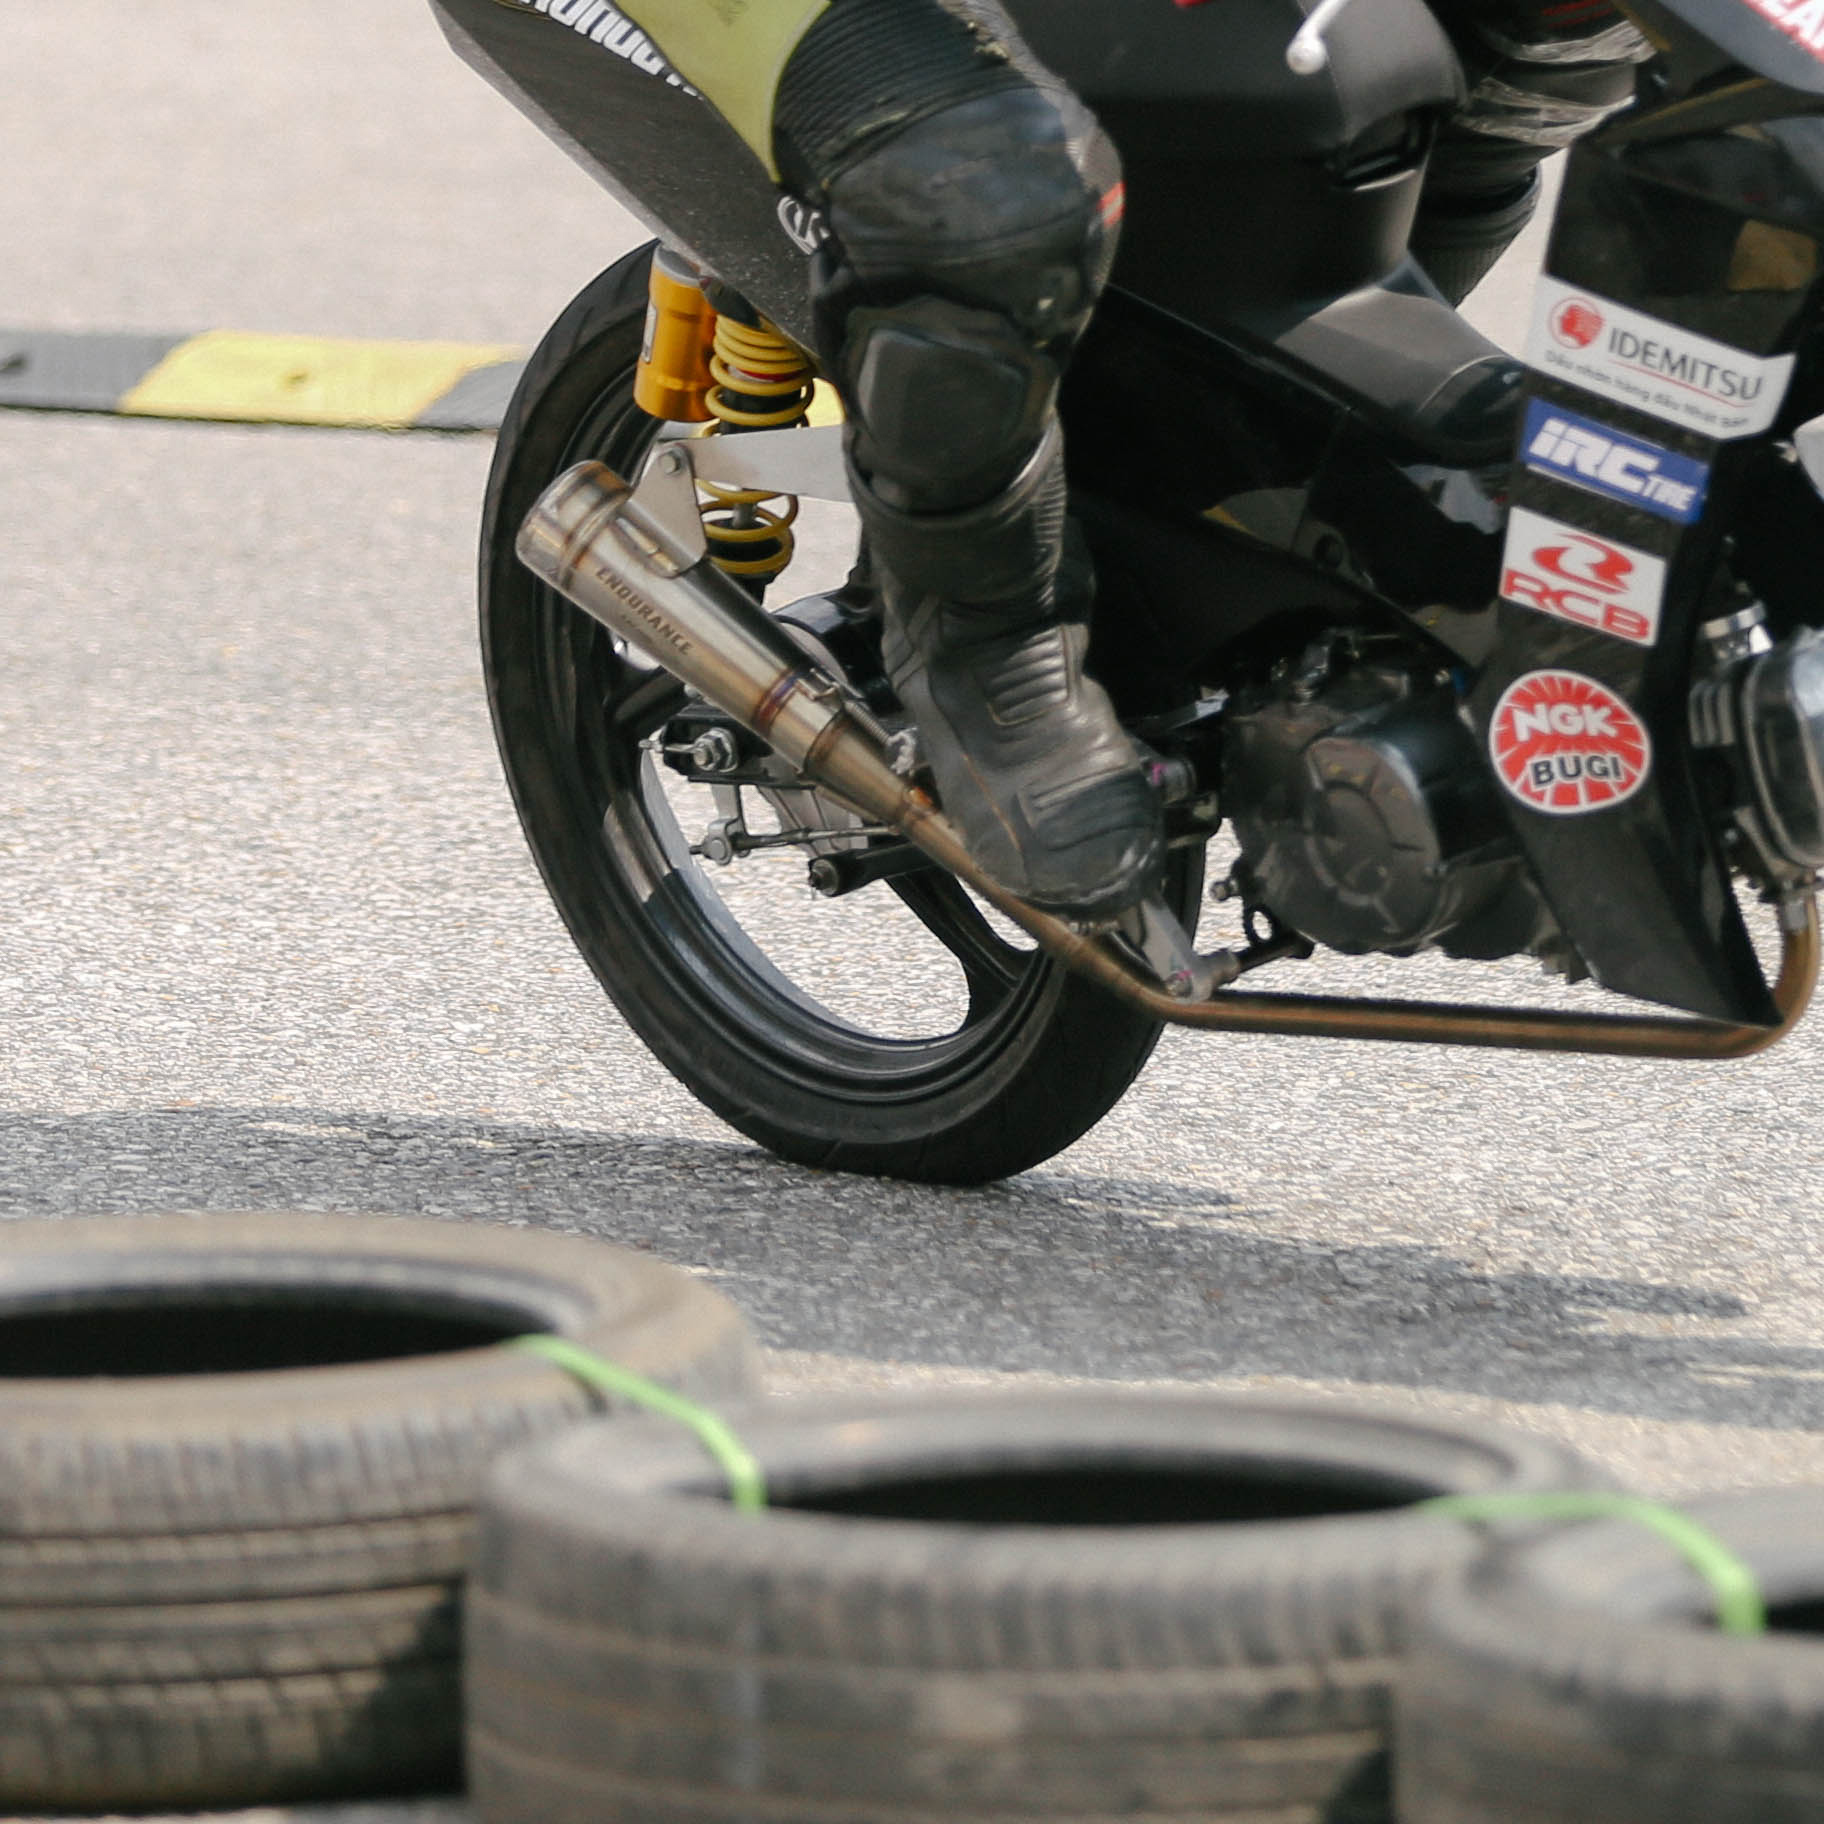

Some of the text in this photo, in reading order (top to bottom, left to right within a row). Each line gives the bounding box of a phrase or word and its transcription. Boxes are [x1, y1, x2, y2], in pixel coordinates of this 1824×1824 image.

[1608, 326, 1764, 400] IDEMITSU
[596, 566, 693, 656] ENDURANCE
[1502, 569, 1651, 639] RCB
[1512, 702, 1619, 743] NGK
[1530, 754, 1622, 787] BUGI
